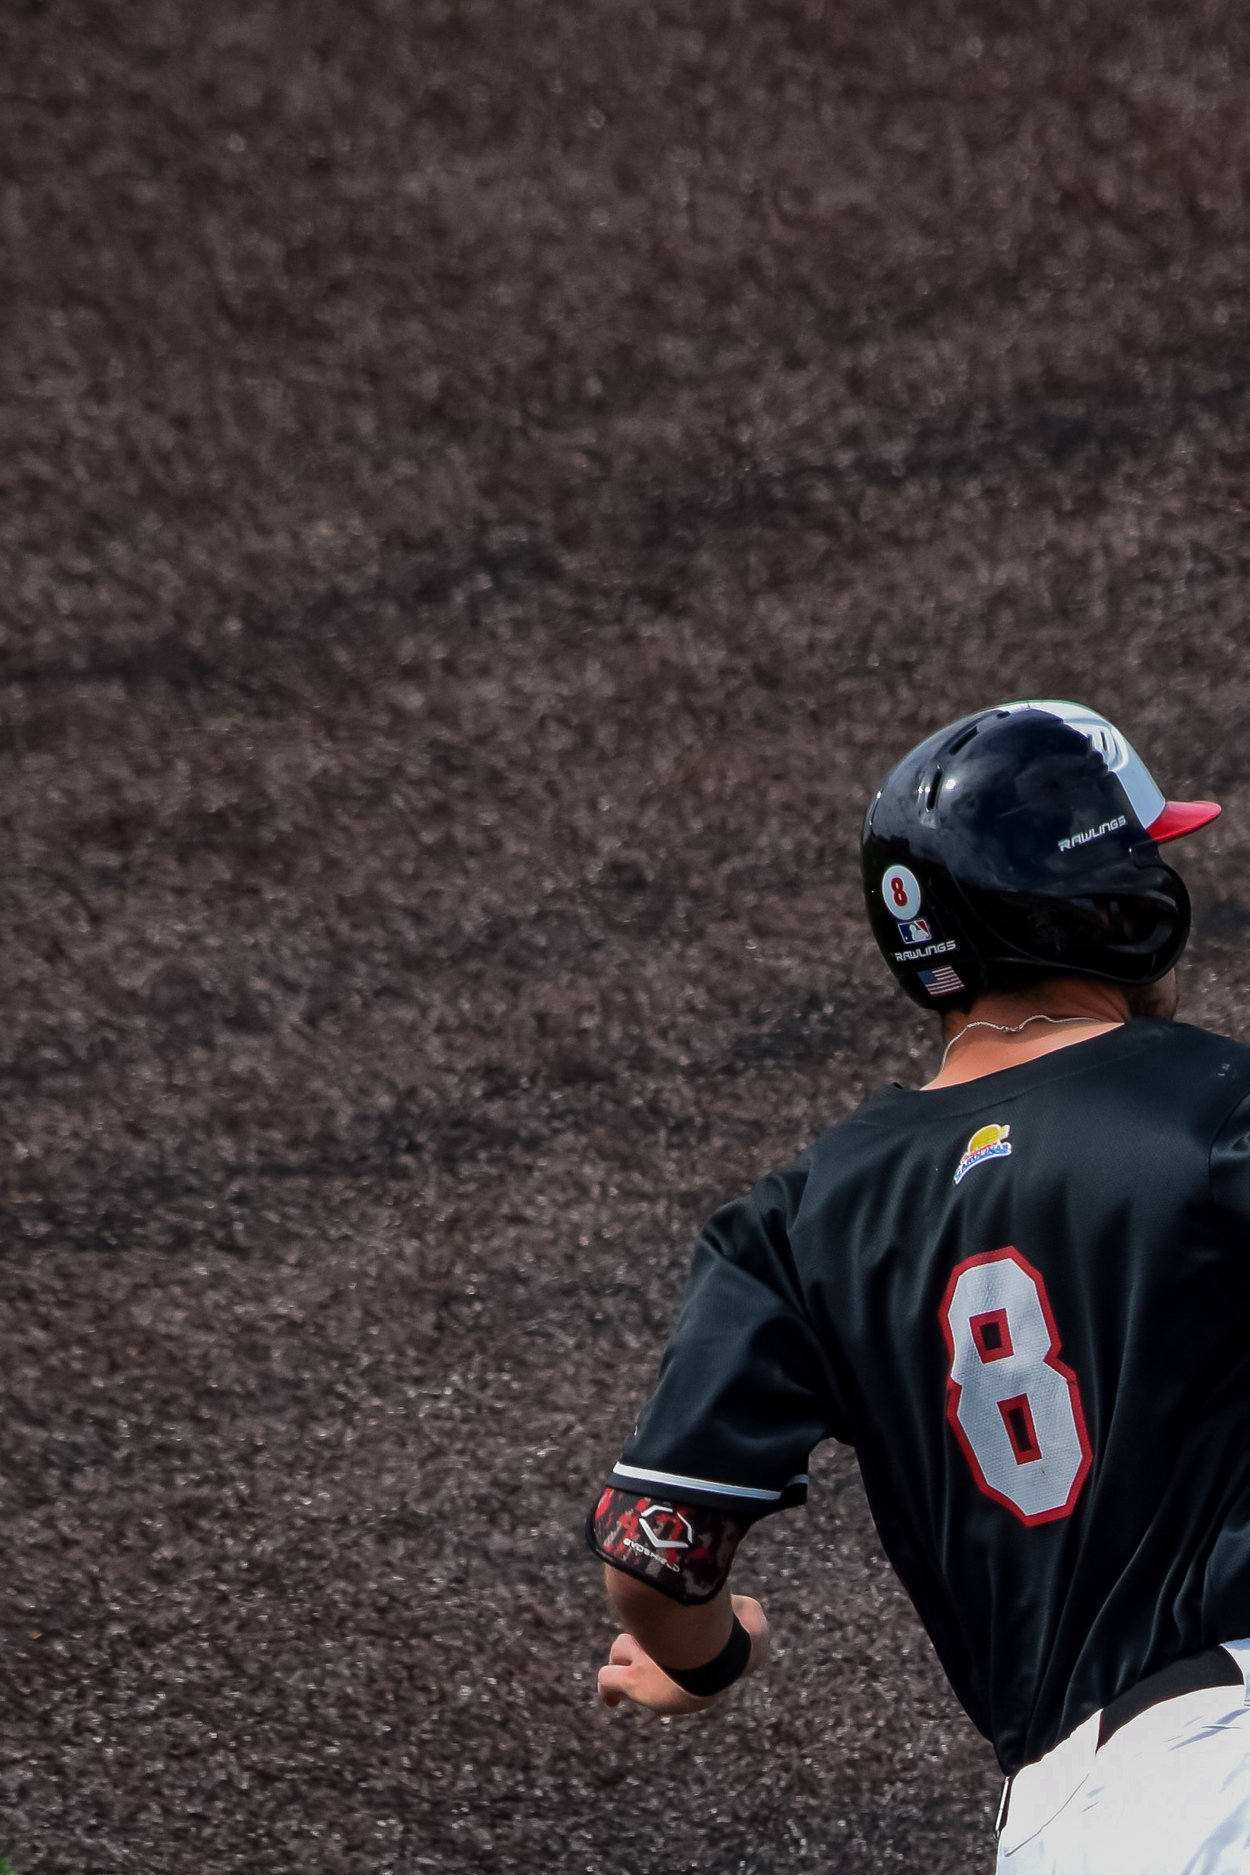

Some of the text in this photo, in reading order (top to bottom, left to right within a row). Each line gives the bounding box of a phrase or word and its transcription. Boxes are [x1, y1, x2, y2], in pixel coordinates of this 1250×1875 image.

[1058, 815, 1126, 852] RAWLINGS
[890, 877, 908, 907] 8
[894, 939, 956, 961] RAWLINGS
[938, 1245, 1093, 1527] 8
